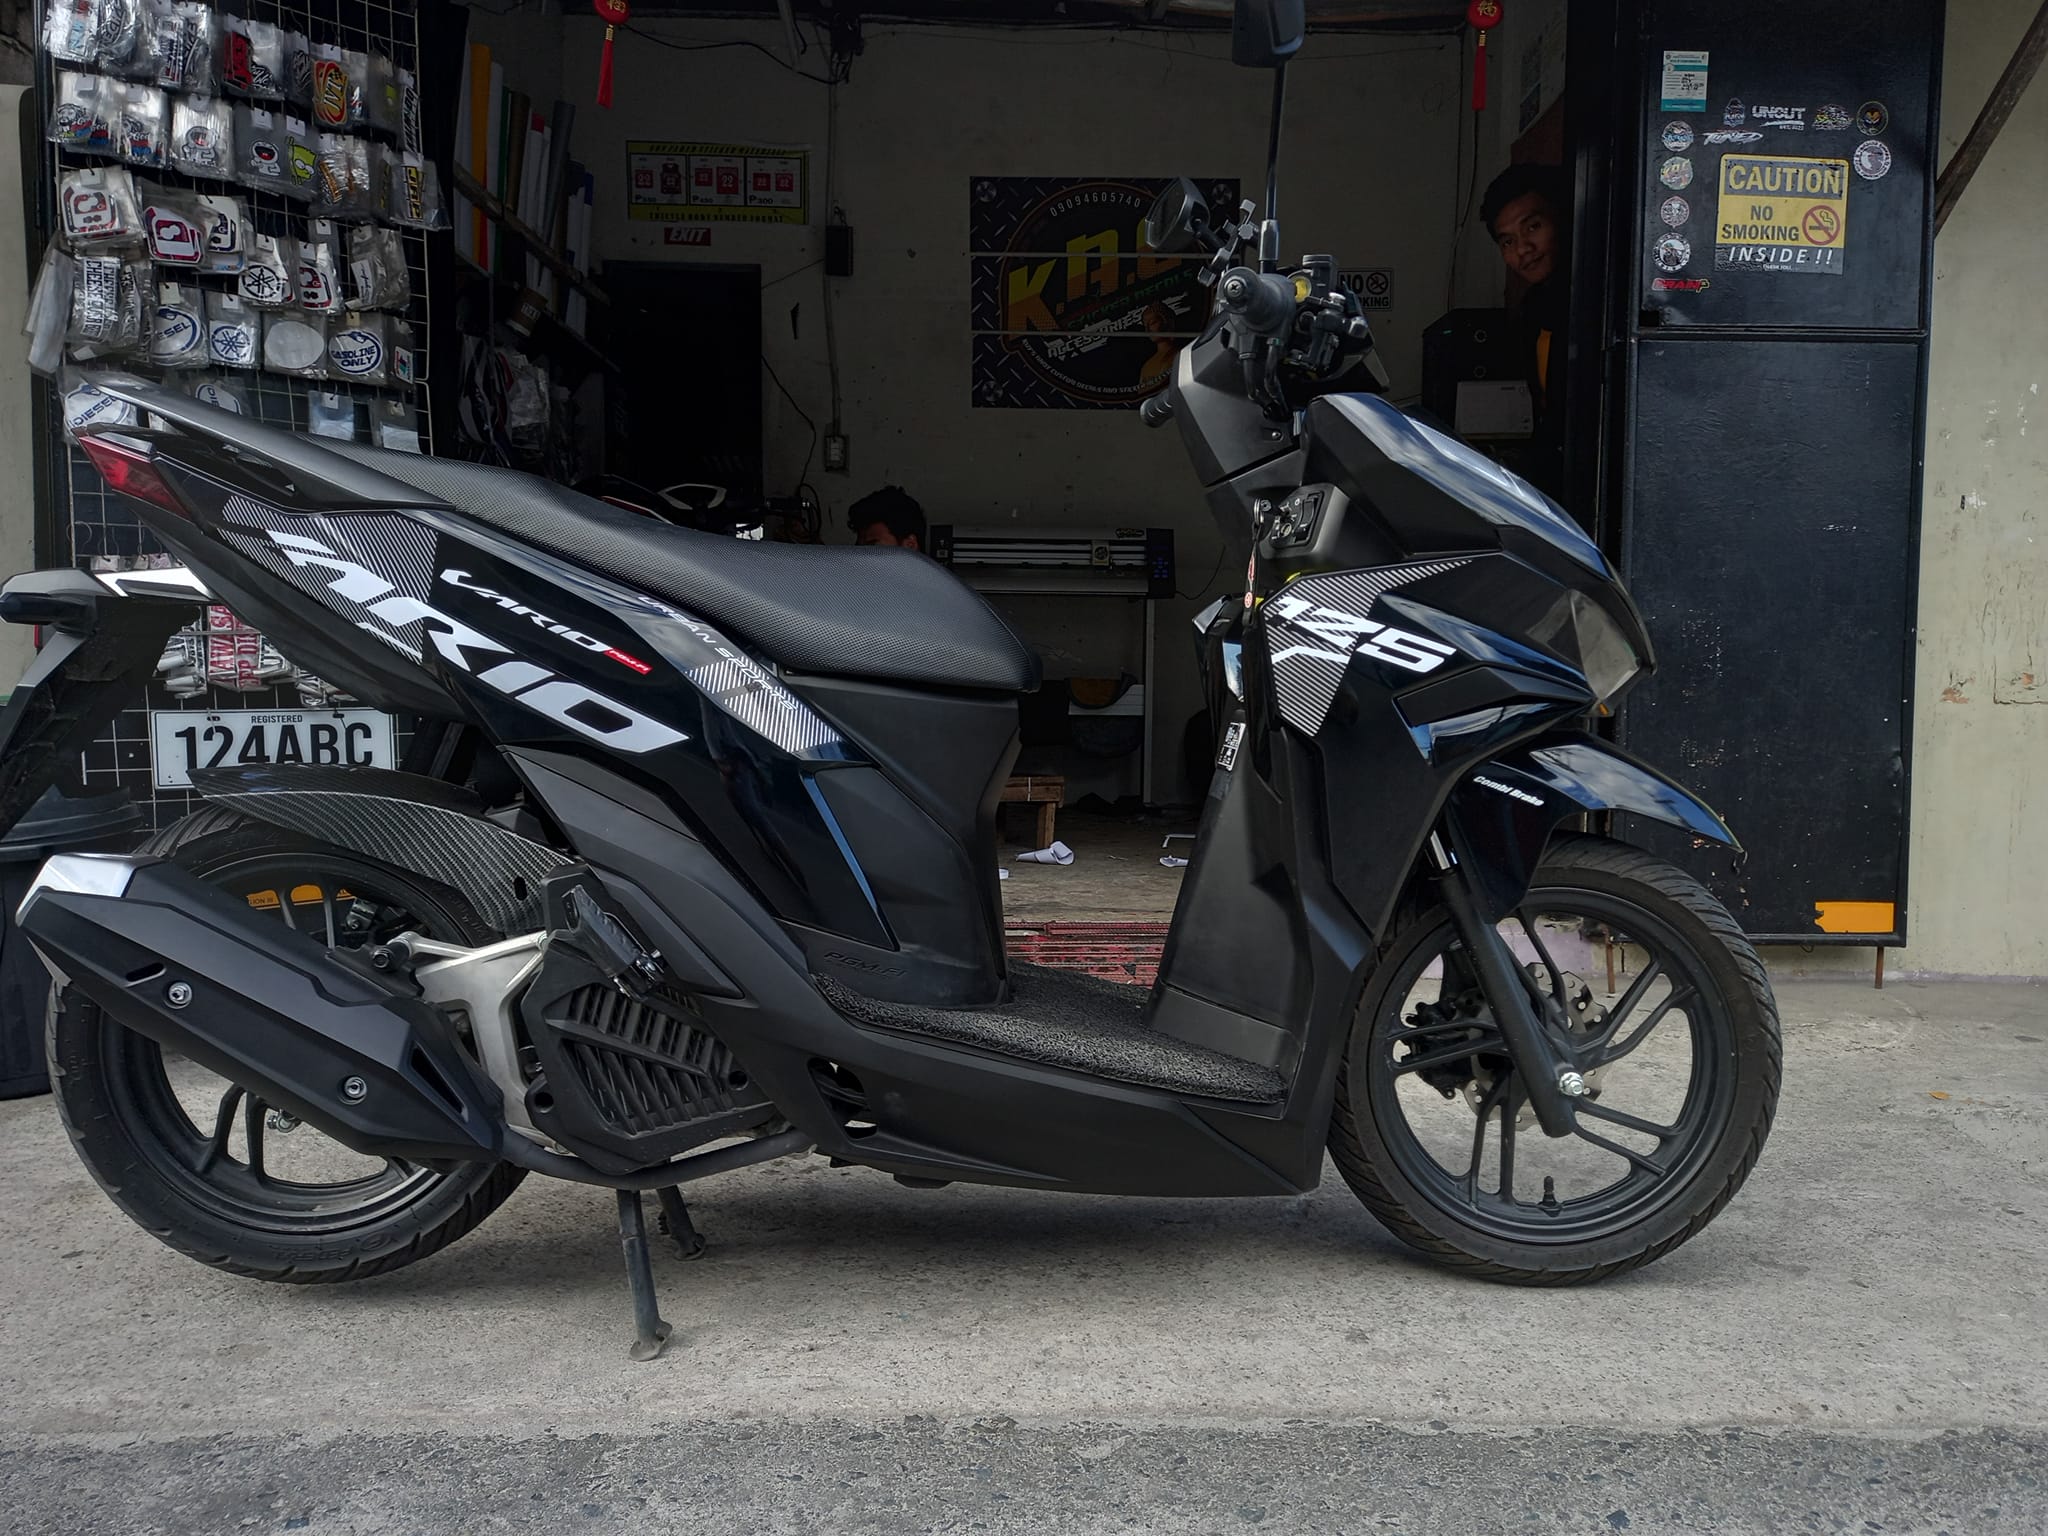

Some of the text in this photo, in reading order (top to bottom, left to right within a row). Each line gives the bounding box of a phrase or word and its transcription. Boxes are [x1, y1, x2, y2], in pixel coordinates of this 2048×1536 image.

[1751, 105, 1806, 120] UNCUT
[1729, 165, 1840, 194] CAUTION
[1049, 191, 1142, 217] 09094605740
[1750, 205, 1773, 221] NO
[669, 228, 708, 243] EXIT
[1721, 224, 1800, 242] SMOKING
[1729, 246, 1808, 264] INSIDE
[1340, 274, 1363, 294] NO
[333, 345, 377, 359] GASOLINE
[341, 356, 373, 367] ONLY
[439, 569, 609, 653] VARIO
[638, 596, 798, 710] URBAN SPORTS
[251, 715, 303, 724] REGISTERED
[175, 722, 373, 769] 124ABC
[1473, 776, 1545, 806] Combi Brake
